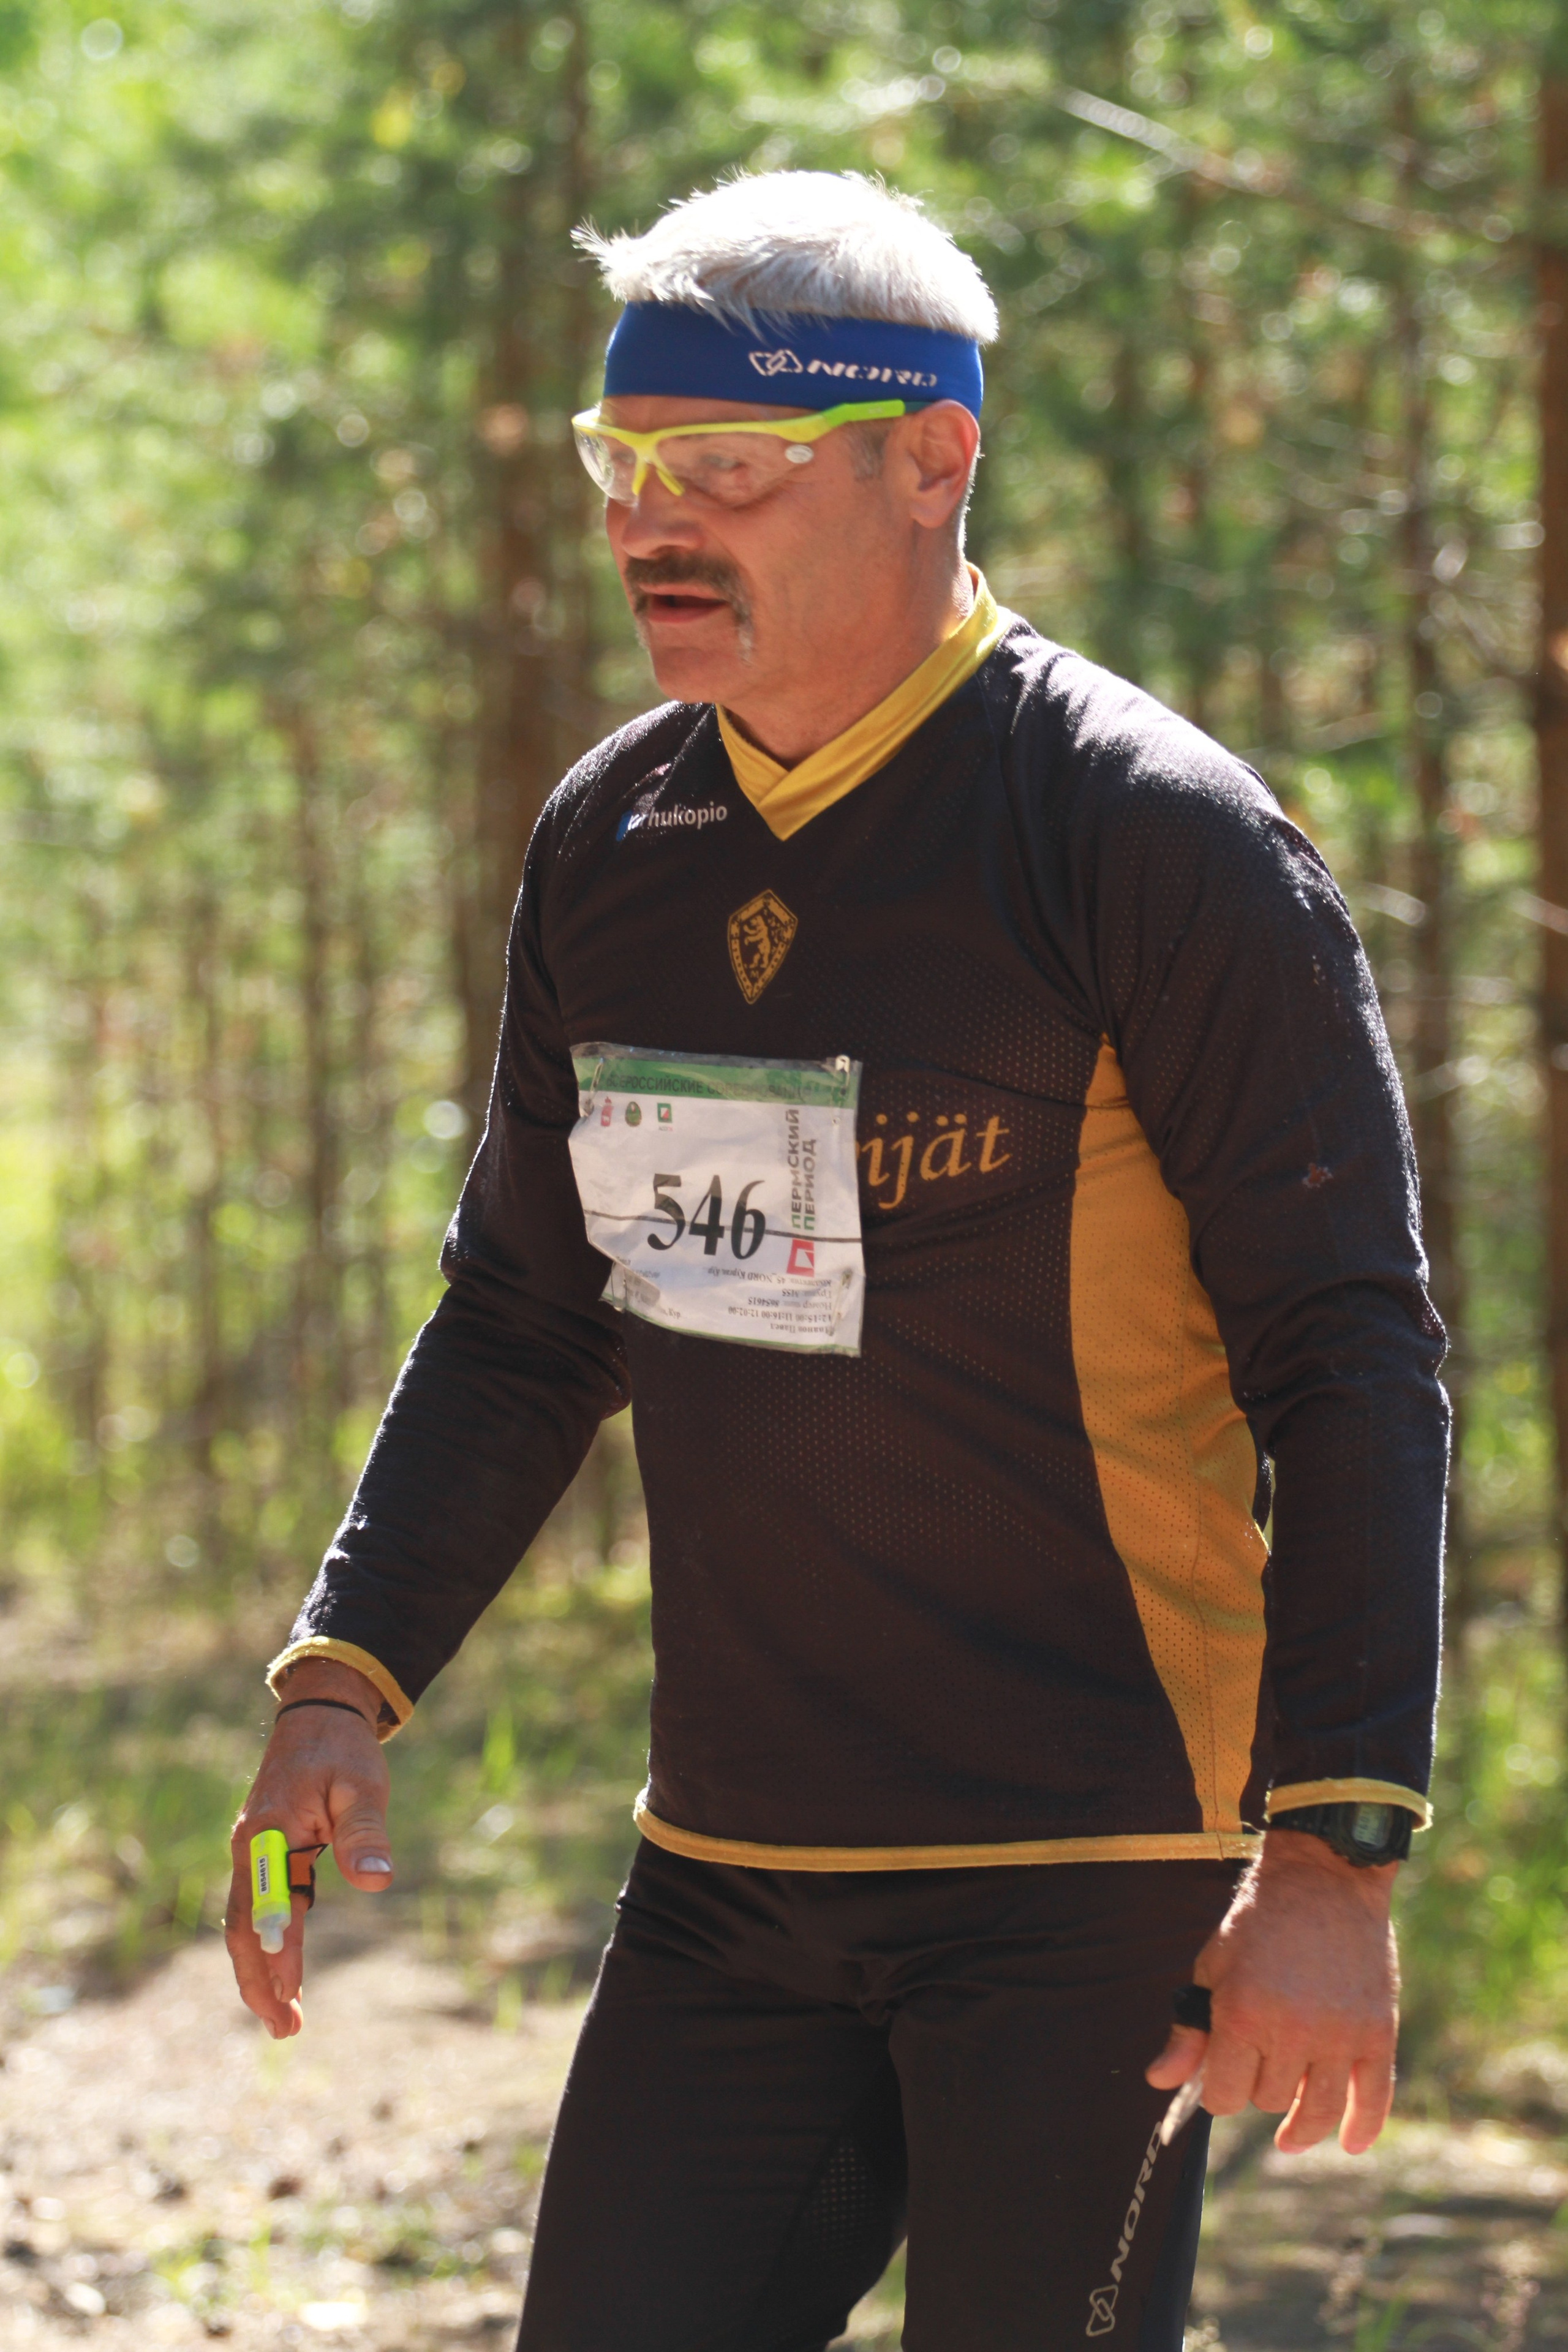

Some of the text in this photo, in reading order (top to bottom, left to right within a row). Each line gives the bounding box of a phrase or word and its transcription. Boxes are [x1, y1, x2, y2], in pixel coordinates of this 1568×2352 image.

[785, 1109, 802, 1229] ПЕРМСКИЙ
[802, 1139, 816, 1231] ПЕРИОД
[855, 1111, 1010, 1210] ijät
[647, 1173, 766, 1260] 546
[728, 1306, 759, 1317] 12:02:00
